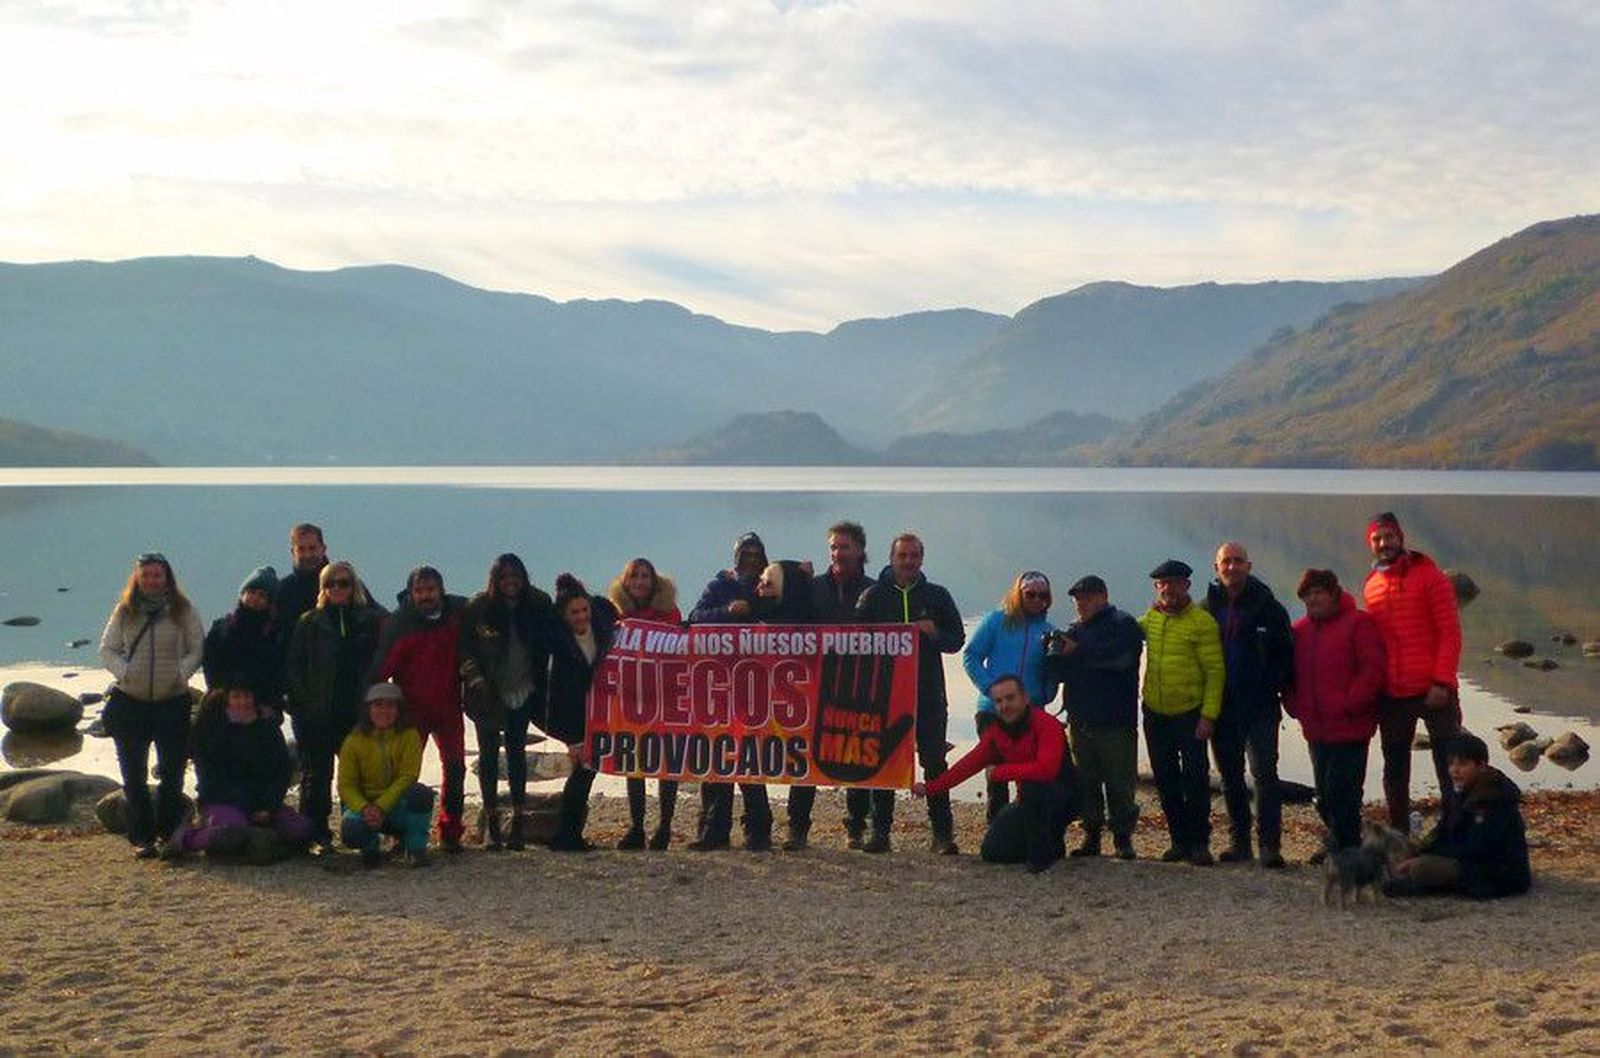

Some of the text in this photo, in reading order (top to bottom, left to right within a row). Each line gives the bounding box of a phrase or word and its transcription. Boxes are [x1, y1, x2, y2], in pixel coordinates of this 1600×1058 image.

[645, 630, 689, 655] VIDA
[693, 632, 733, 656] NOS
[738, 628, 817, 656] ÑUESOS
[822, 632, 914, 656] PUEBROS
[590, 655, 810, 731] FUEGOS
[822, 705, 881, 733] NUNCA
[592, 731, 810, 780] PROVOCAOS
